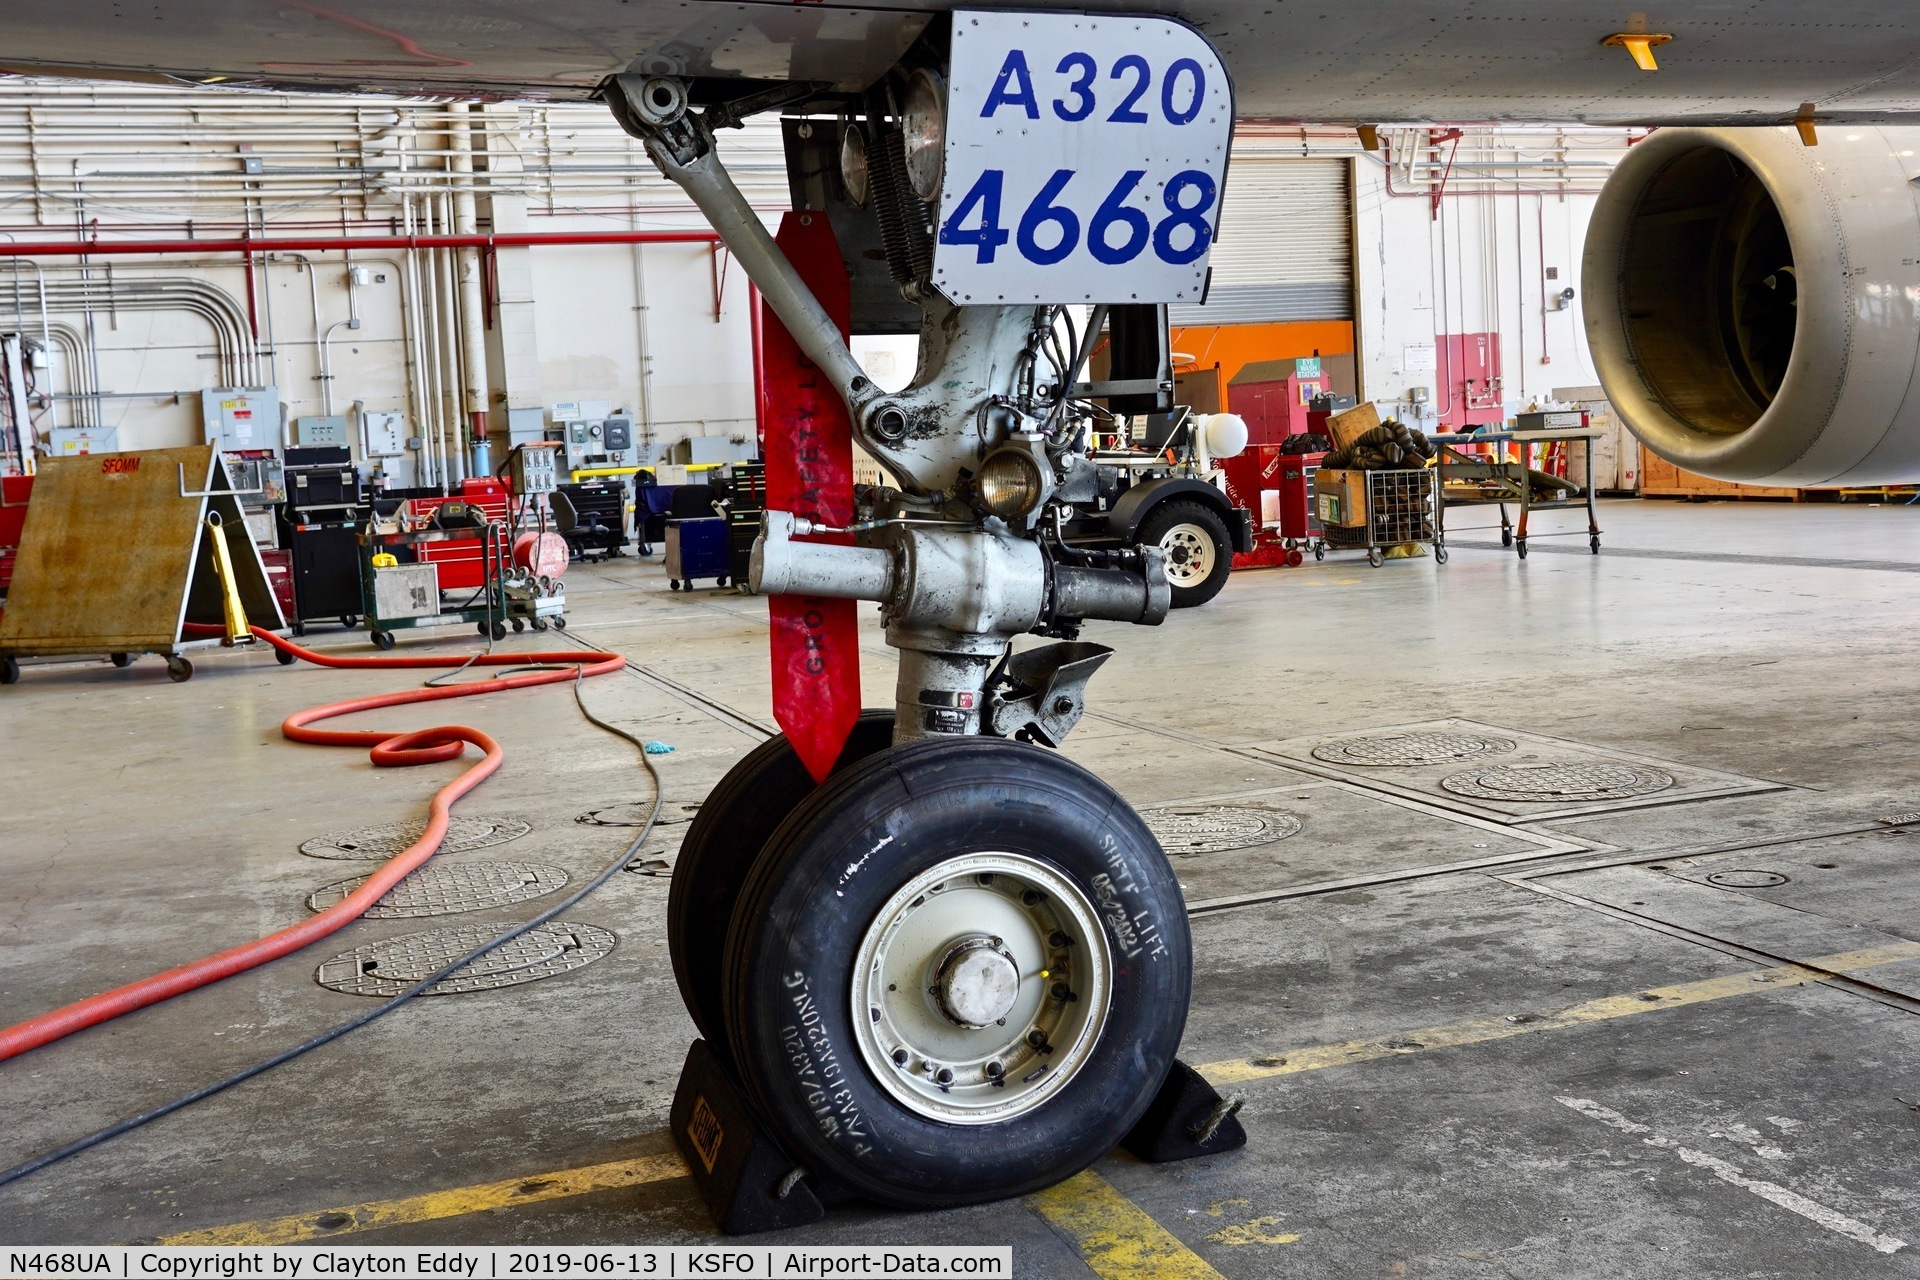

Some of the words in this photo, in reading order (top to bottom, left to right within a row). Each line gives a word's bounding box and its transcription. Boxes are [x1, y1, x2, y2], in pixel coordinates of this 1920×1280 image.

[980, 49, 1206, 125] A320
[939, 169, 1216, 266] 4668
[102, 457, 141, 473] SFOMM
[1133, 910, 1169, 962] LIFE
